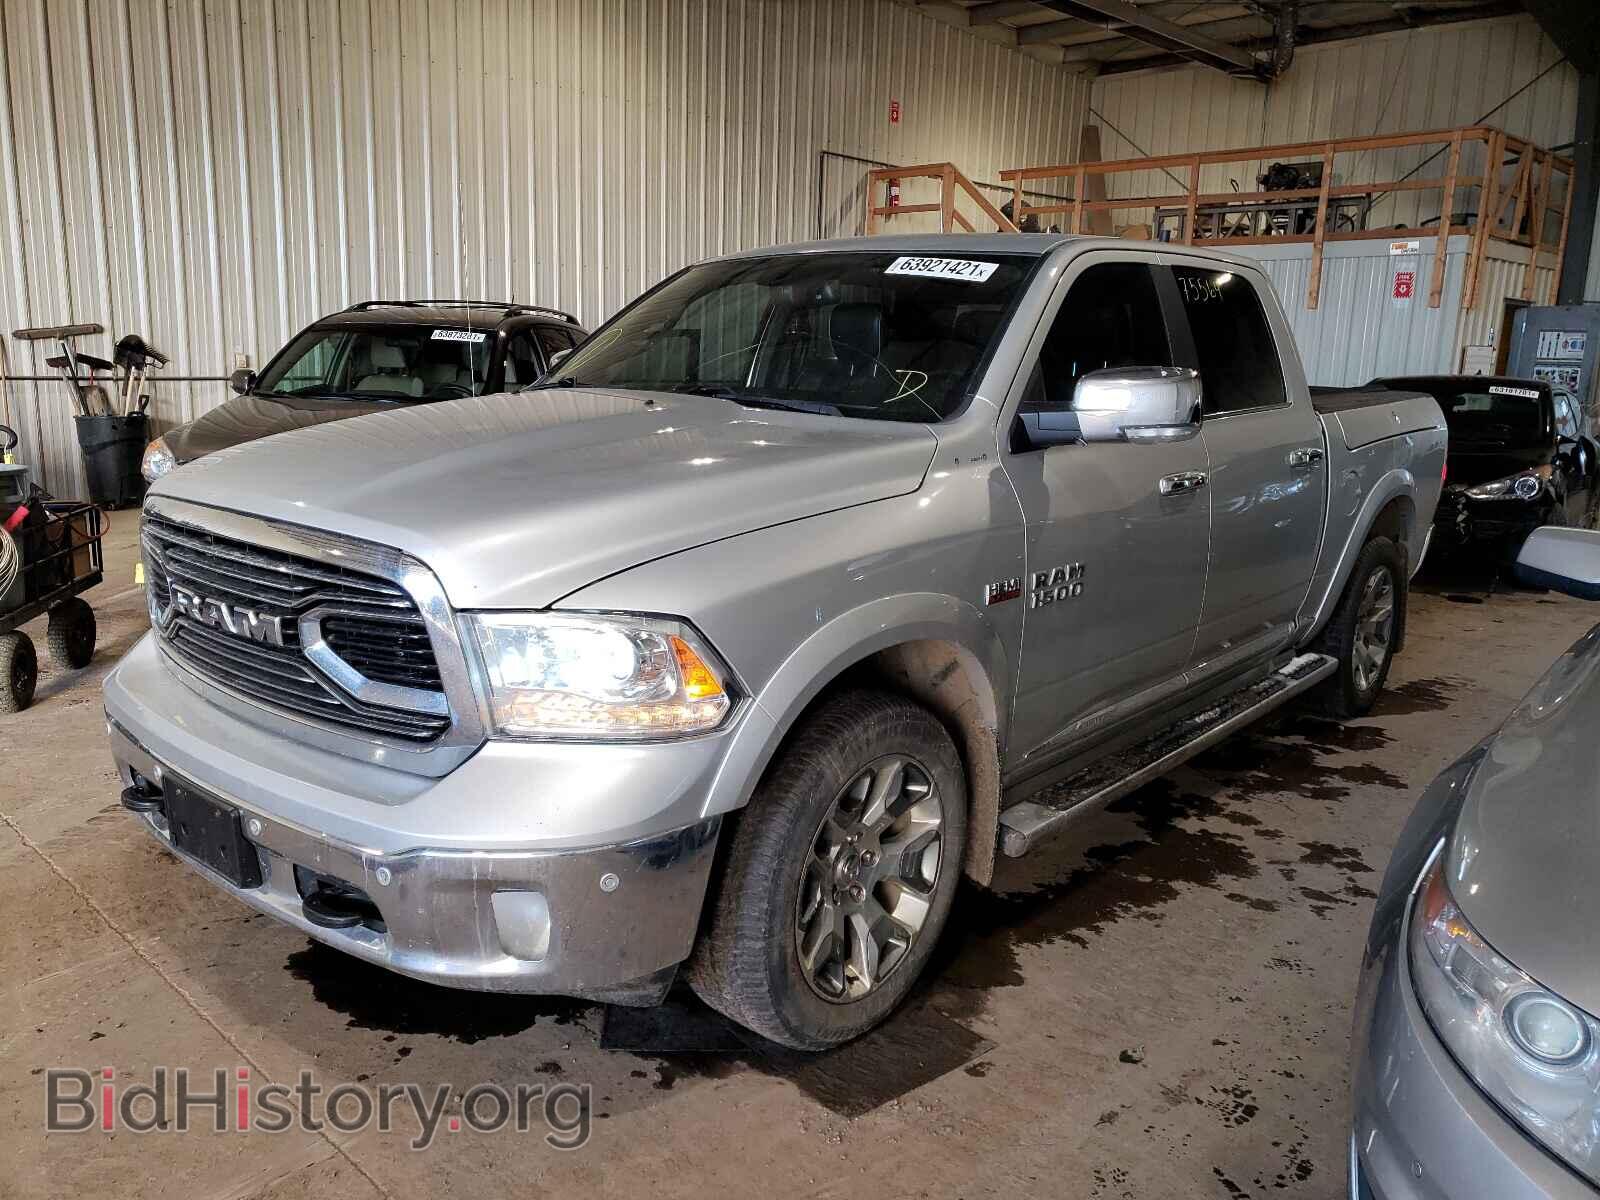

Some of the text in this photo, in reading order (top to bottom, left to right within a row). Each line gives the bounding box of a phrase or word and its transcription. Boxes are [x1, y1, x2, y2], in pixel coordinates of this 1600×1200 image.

[1032, 562, 1084, 591] RAM
[1031, 582, 1083, 609] 1500
[171, 584, 284, 647] RAM
